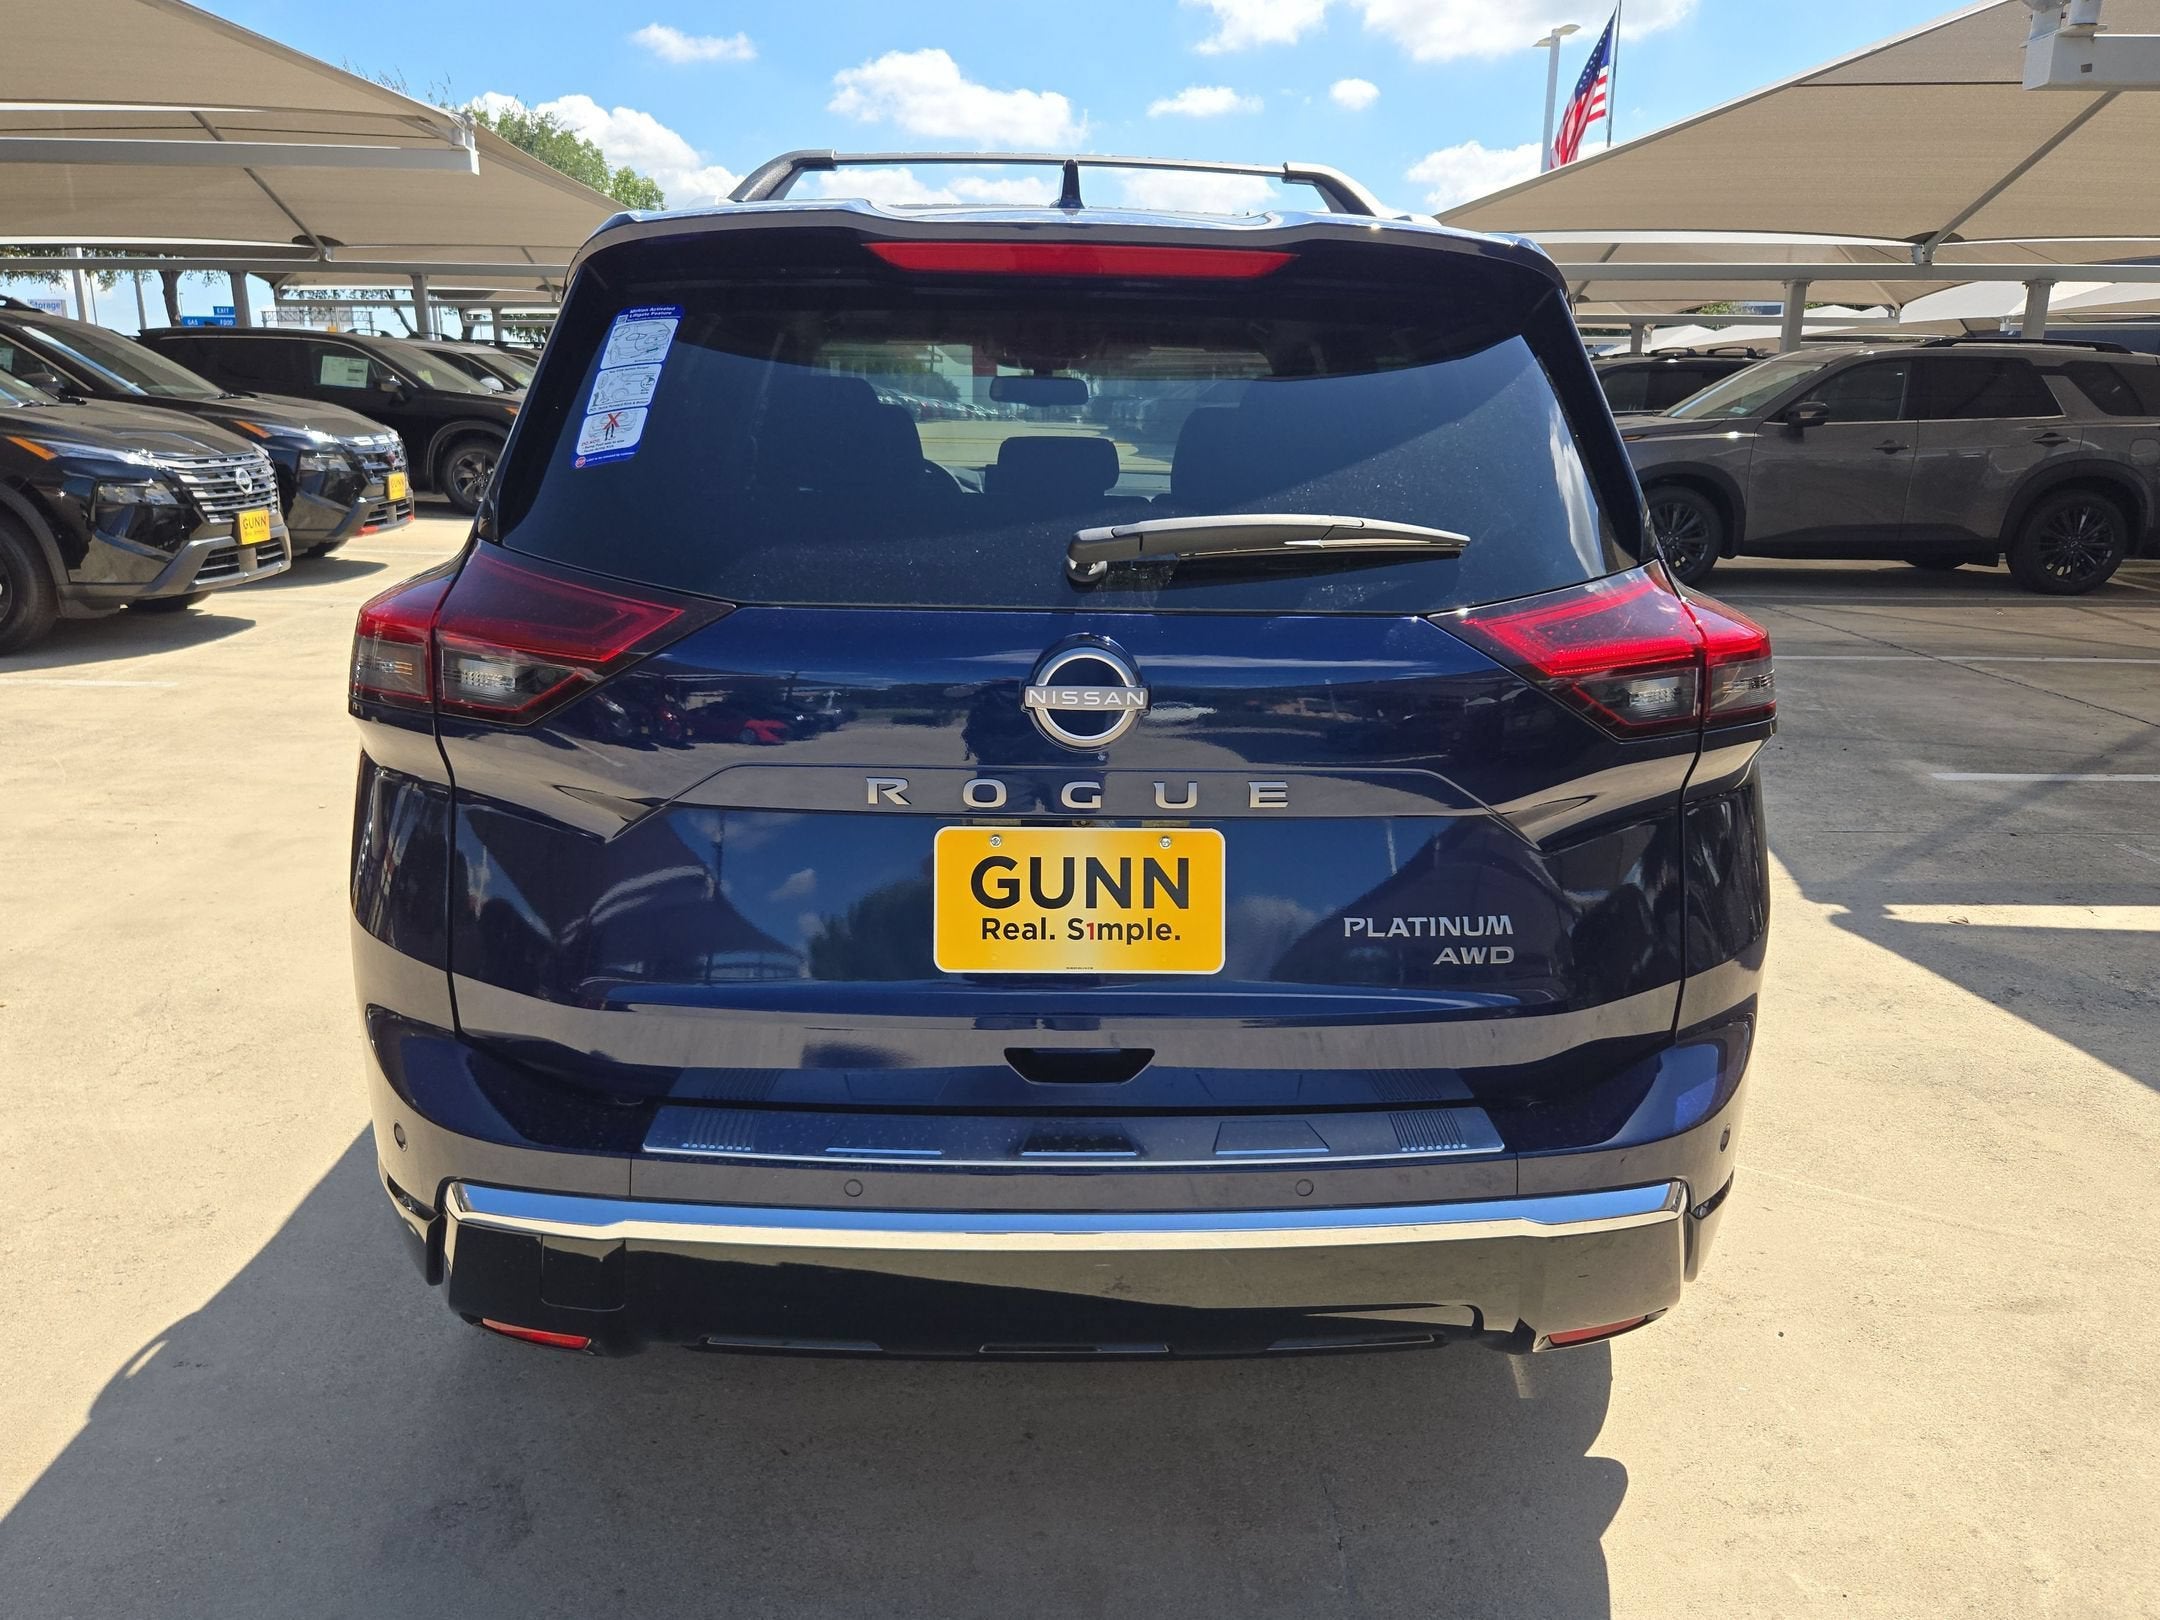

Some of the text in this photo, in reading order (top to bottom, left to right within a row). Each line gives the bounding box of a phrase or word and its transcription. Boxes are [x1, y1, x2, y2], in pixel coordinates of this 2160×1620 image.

[242, 515, 267, 530] GUNN
[1029, 690, 1145, 706] NISSAN
[865, 776, 1289, 810] ROGUE
[970, 855, 1190, 910] GUNN
[981, 917, 1056, 941] Real.
[1343, 915, 1514, 937] PLATINUM
[1432, 946, 1515, 965] AWD
